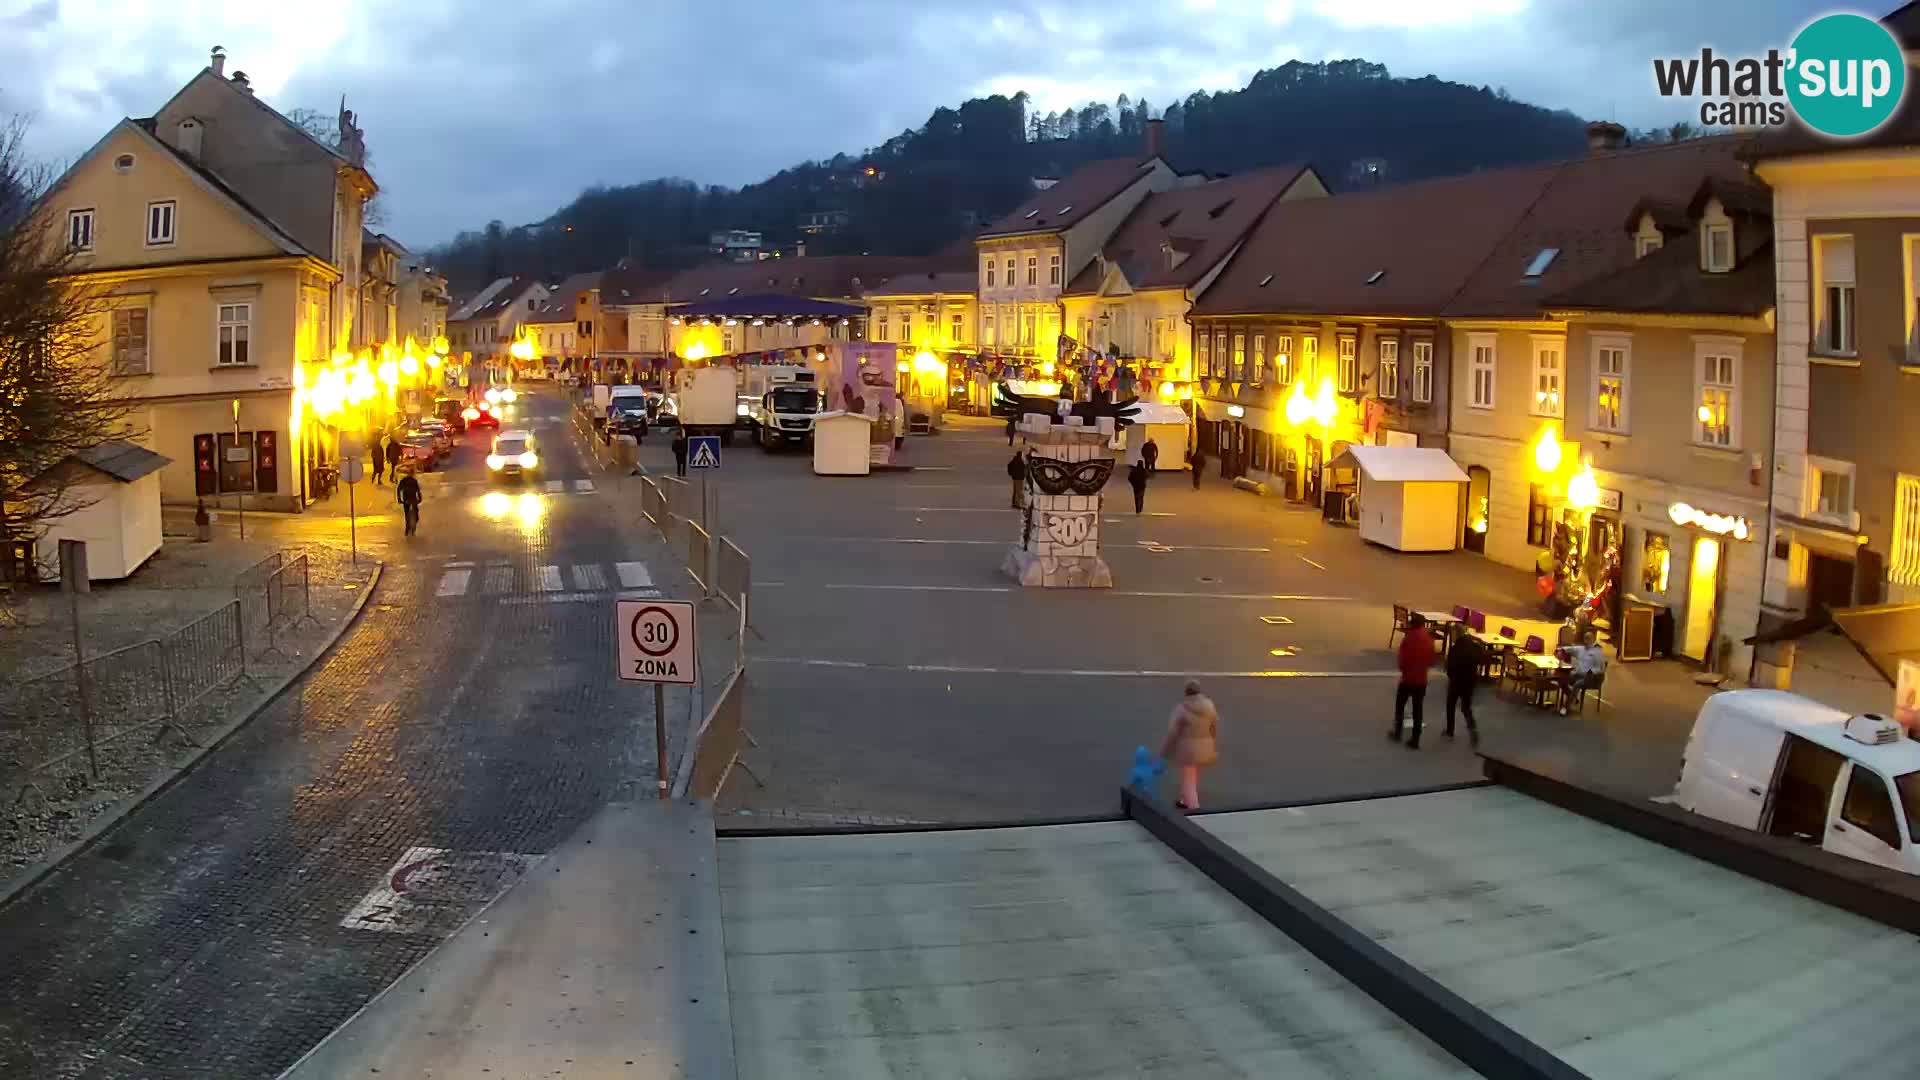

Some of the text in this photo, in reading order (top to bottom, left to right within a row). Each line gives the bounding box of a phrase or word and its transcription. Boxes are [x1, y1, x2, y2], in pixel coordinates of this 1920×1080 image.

[1048, 516, 1087, 545] 200
[644, 622, 668, 643] 30
[634, 659, 678, 676] ZONA
